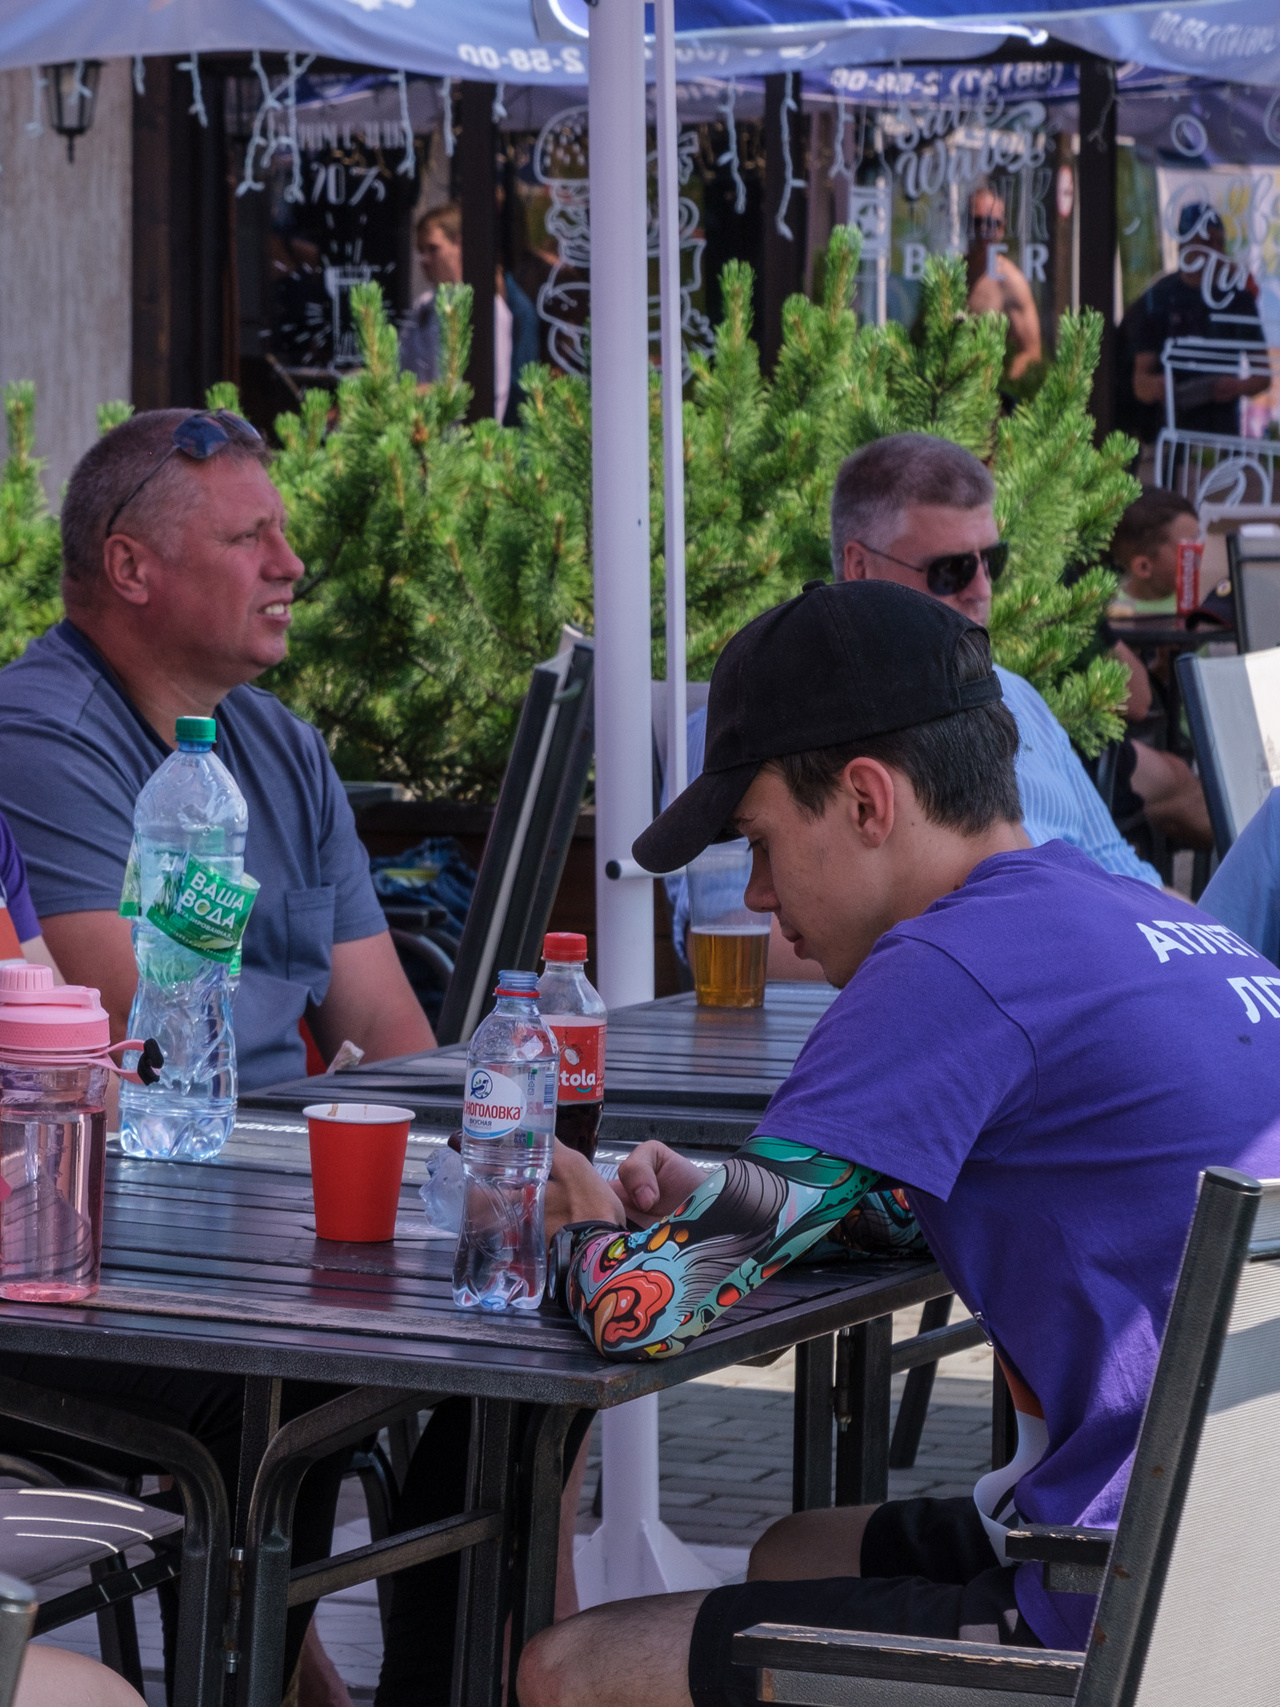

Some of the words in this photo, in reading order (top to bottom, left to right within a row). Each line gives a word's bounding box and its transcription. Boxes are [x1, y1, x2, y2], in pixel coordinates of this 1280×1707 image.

[903, 242, 1049, 284] BER
[181, 888, 237, 929] ВОДА
[190, 871, 246, 911] ВАША
[1136, 920, 1261, 964] АТЛЕТ
[558, 1069, 597, 1086] tola
[469, 1118, 493, 1127] ВКУСНАЯ
